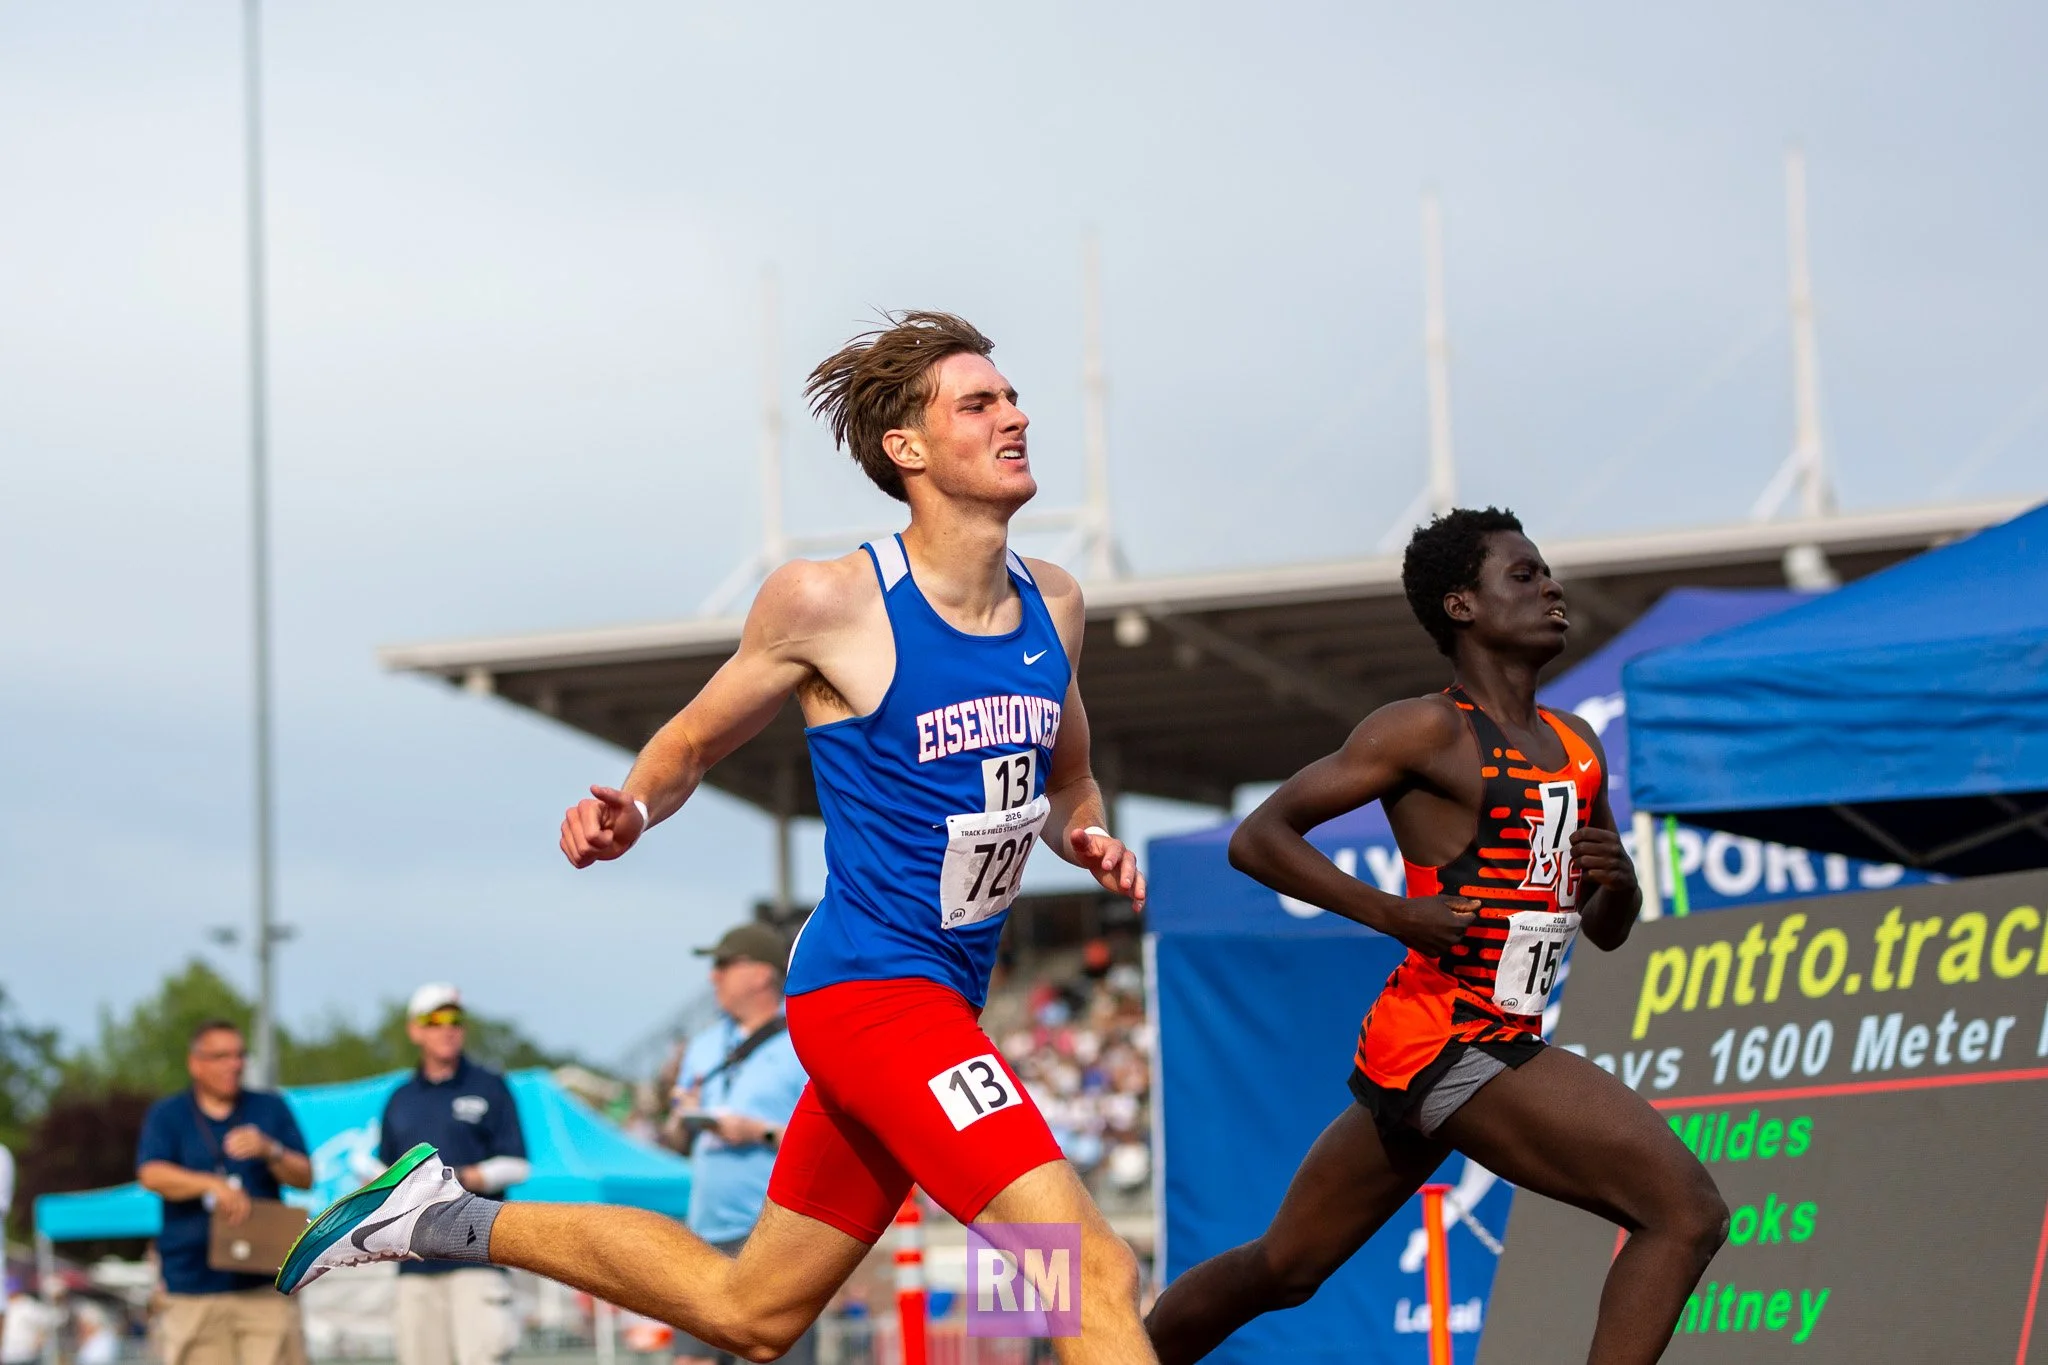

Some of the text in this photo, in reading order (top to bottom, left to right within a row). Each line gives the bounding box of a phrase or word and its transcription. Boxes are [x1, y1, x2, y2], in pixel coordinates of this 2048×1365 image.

[916, 695, 1062, 763] EISENHOWER
[995, 756, 1032, 811] 13
[961, 829, 981, 837] TRACK
[987, 827, 1003, 835] FIELD
[1003, 824, 1018, 833] STATE
[1548, 786, 1570, 849] 7
[1525, 939, 1566, 996] 15
[1631, 905, 2048, 1040] pntfo.trac
[1558, 1043, 1684, 1091] ys
[1710, 1019, 1834, 1085] 1600
[1851, 1008, 2017, 1074] Meter
[948, 1060, 1008, 1116] 13
[1728, 1192, 1818, 1247] oks
[1672, 1280, 1832, 1344] itney
